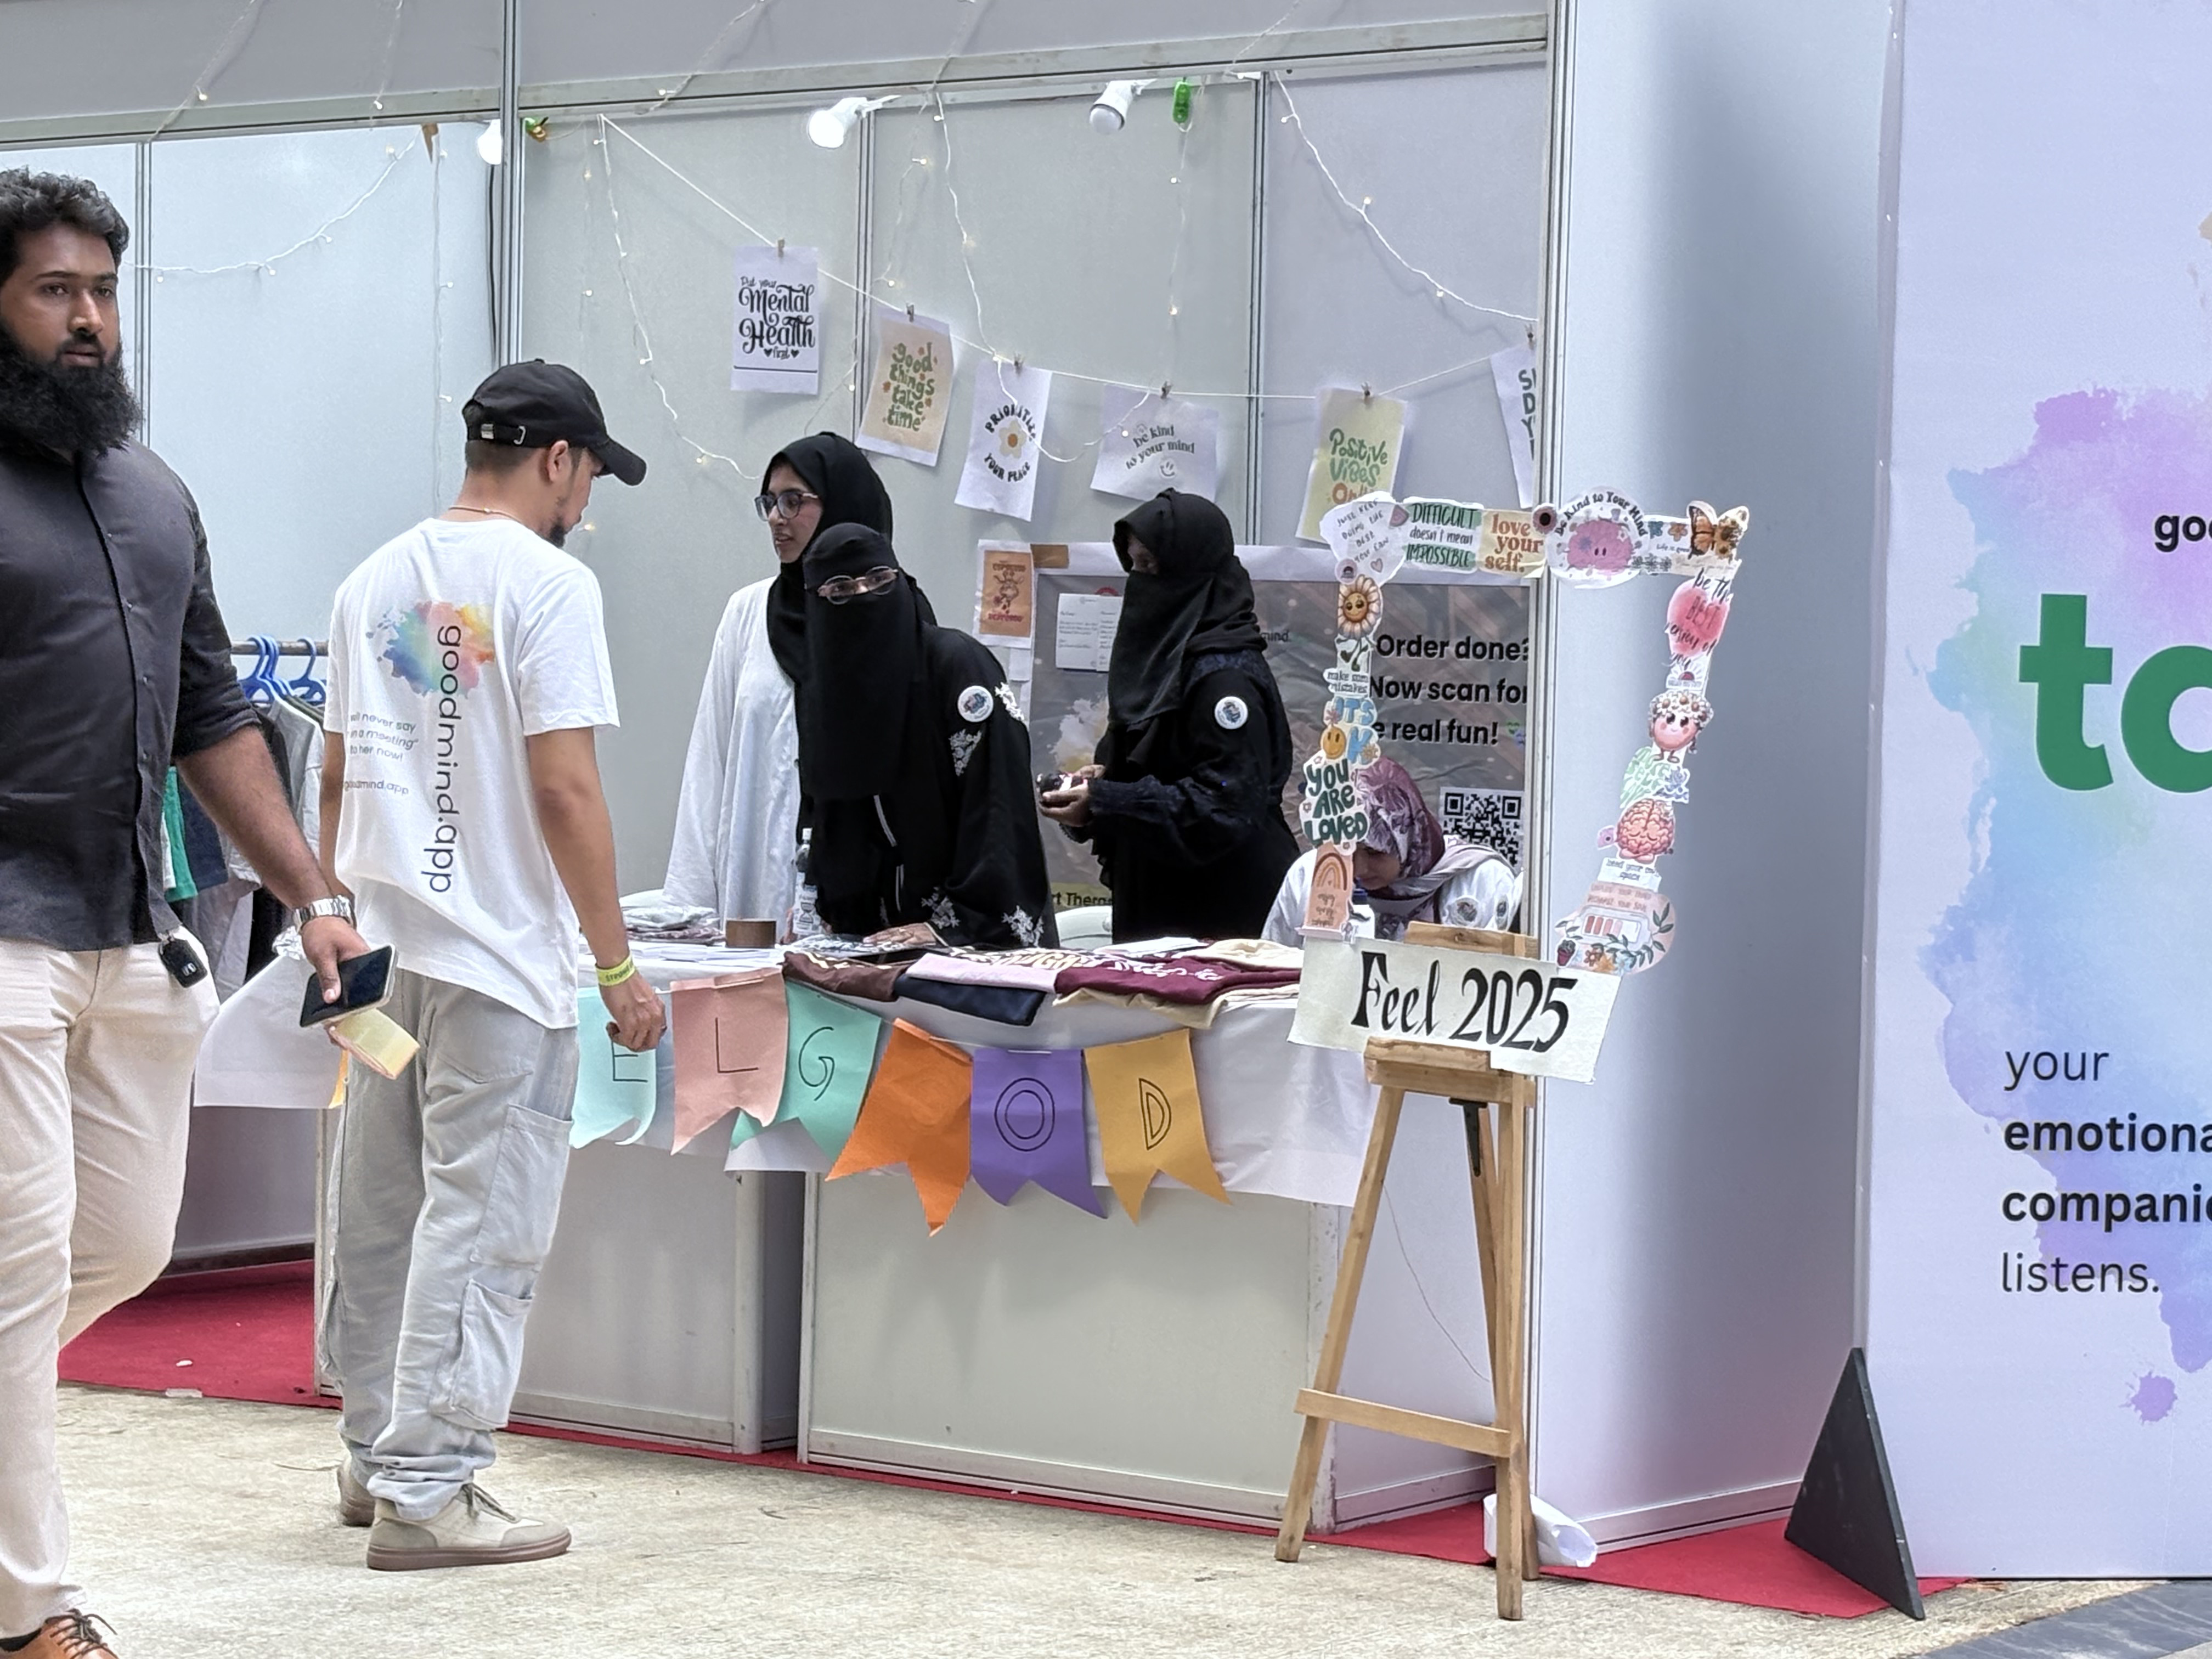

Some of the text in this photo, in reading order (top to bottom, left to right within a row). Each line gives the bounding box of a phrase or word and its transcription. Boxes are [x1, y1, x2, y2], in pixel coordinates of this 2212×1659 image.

[738, 284, 815, 327] Mental
[738, 315, 815, 354] Health
[891, 342, 933, 374] good
[889, 363, 935, 400] things
[892, 384, 924, 415] take
[887, 403, 922, 432] time
[1132, 425, 1175, 448] be kind
[1138, 442, 1165, 464] your
[1167, 439, 1195, 454] mind
[1592, 493, 1604, 503] to
[1412, 503, 1479, 529] DIFFICULT
[1492, 514, 1531, 537] love
[1406, 543, 1471, 567] IMPOSSIBLE
[1494, 535, 1544, 555] your
[1485, 551, 1525, 573] self.
[1376, 634, 1449, 658] Order
[1370, 675, 1423, 699] Now
[1427, 681, 1490, 702] scan
[362, 714, 394, 728] never
[396, 721, 416, 734] say
[1392, 719, 1441, 742] real
[1446, 719, 1498, 745] fun!
[420, 624, 462, 893] goodmind.app
[1351, 952, 1578, 1053] Feel 2025
[715, 1017, 759, 1074] L
[798, 1026, 835, 1102] G
[995, 1077, 1055, 1152] O
[1138, 1077, 1172, 1151] D
[2004, 1050, 2109, 1092] your
[2002, 1183, 2212, 1233] compani
[2001, 1251, 2159, 1293] listens.
